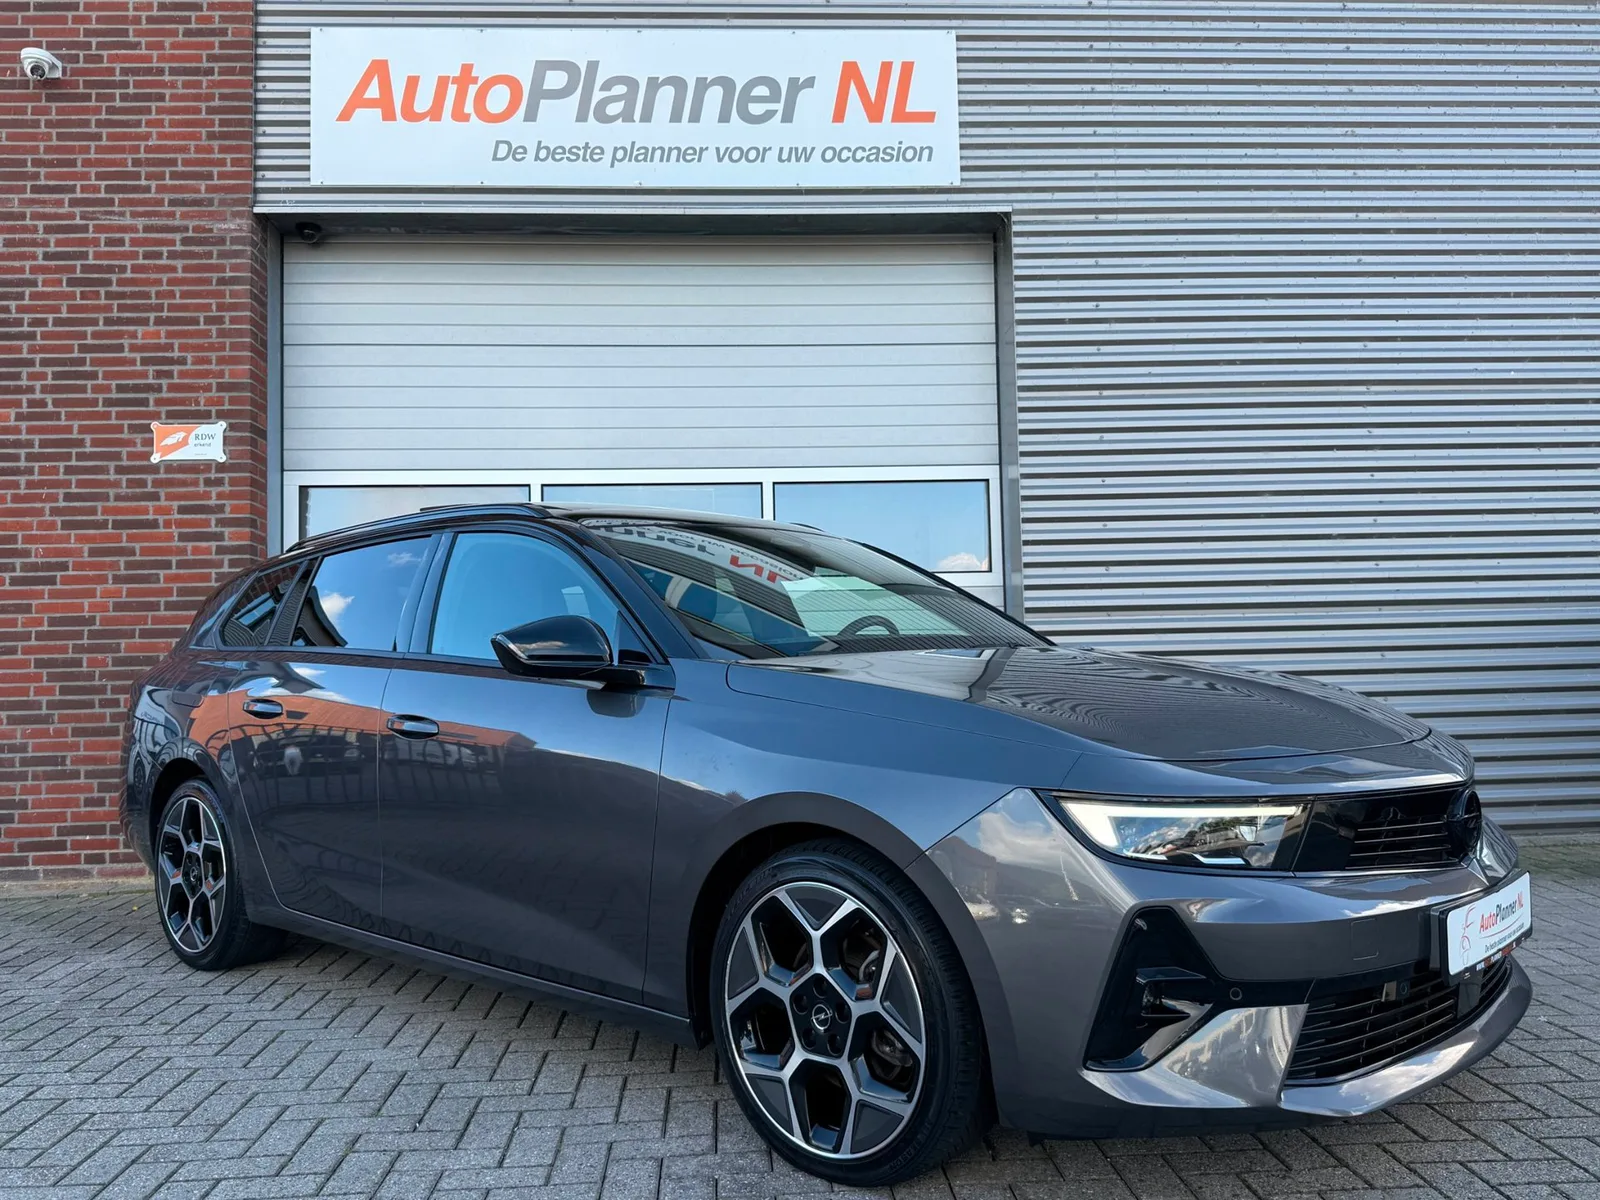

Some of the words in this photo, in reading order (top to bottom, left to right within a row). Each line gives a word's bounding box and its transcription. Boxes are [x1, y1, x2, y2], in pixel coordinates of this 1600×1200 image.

[335, 59, 816, 125] AutoPlanner
[832, 60, 936, 124] NL
[492, 140, 527, 162] De
[534, 140, 605, 163] beste
[610, 141, 709, 168] planner
[715, 146, 772, 163] voor
[778, 147, 816, 163] uw
[821, 141, 933, 163] occasion
[194, 433, 216, 441] RDW
[1479, 899, 1517, 933] AutoPlanner
